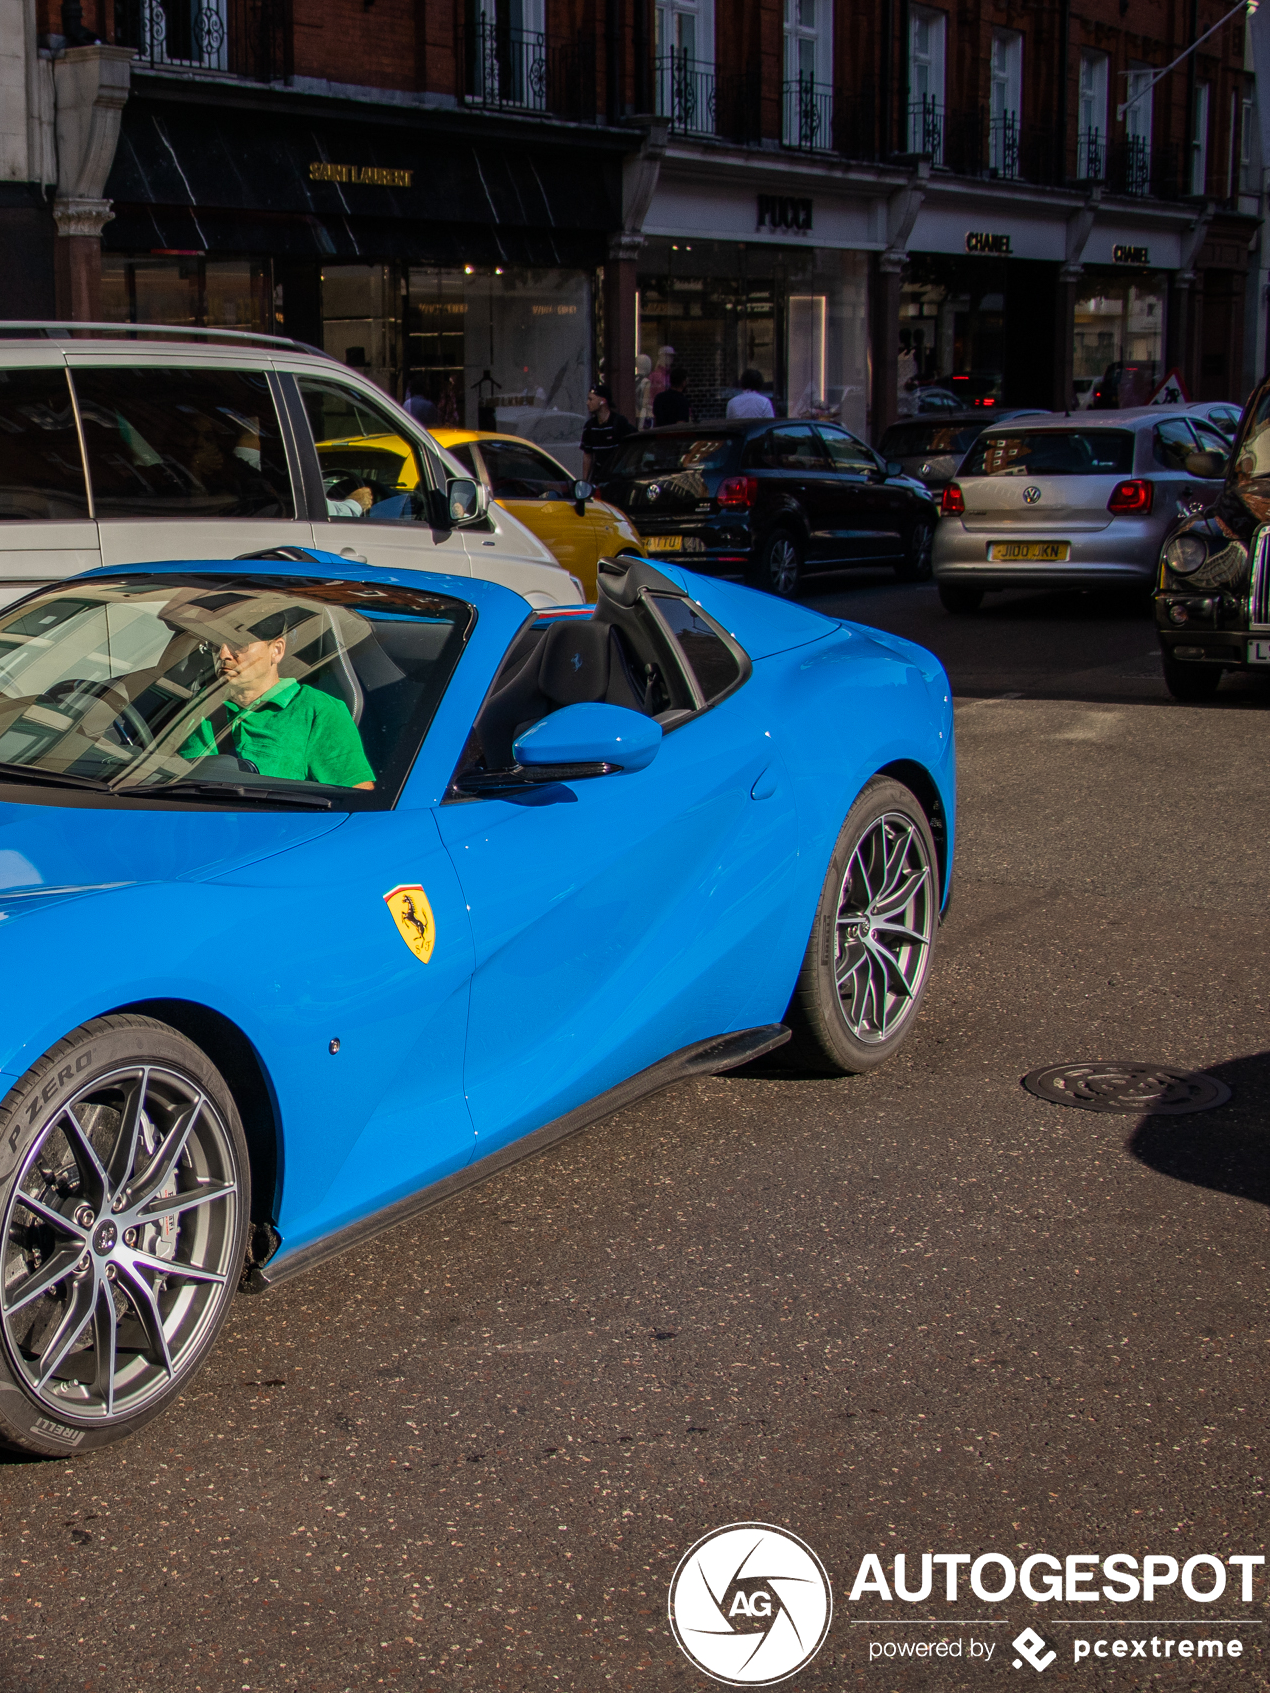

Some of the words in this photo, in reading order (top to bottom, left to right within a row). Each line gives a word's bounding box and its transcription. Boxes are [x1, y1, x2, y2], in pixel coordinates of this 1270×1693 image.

[309, 161, 351, 182] SAINT
[351, 165, 413, 187] LAURENT
[756, 194, 812, 230] PUCCI
[965, 231, 1013, 254] CHANEL
[1112, 244, 1150, 264] CHANEL
[1033, 545, 1060, 558] JKN
[1255, 643, 1270, 660] L
[8, 1124, 21, 1154] P
[25, 1049, 92, 1125] ZERO
[30, 1416, 86, 1447] PIRELLI
